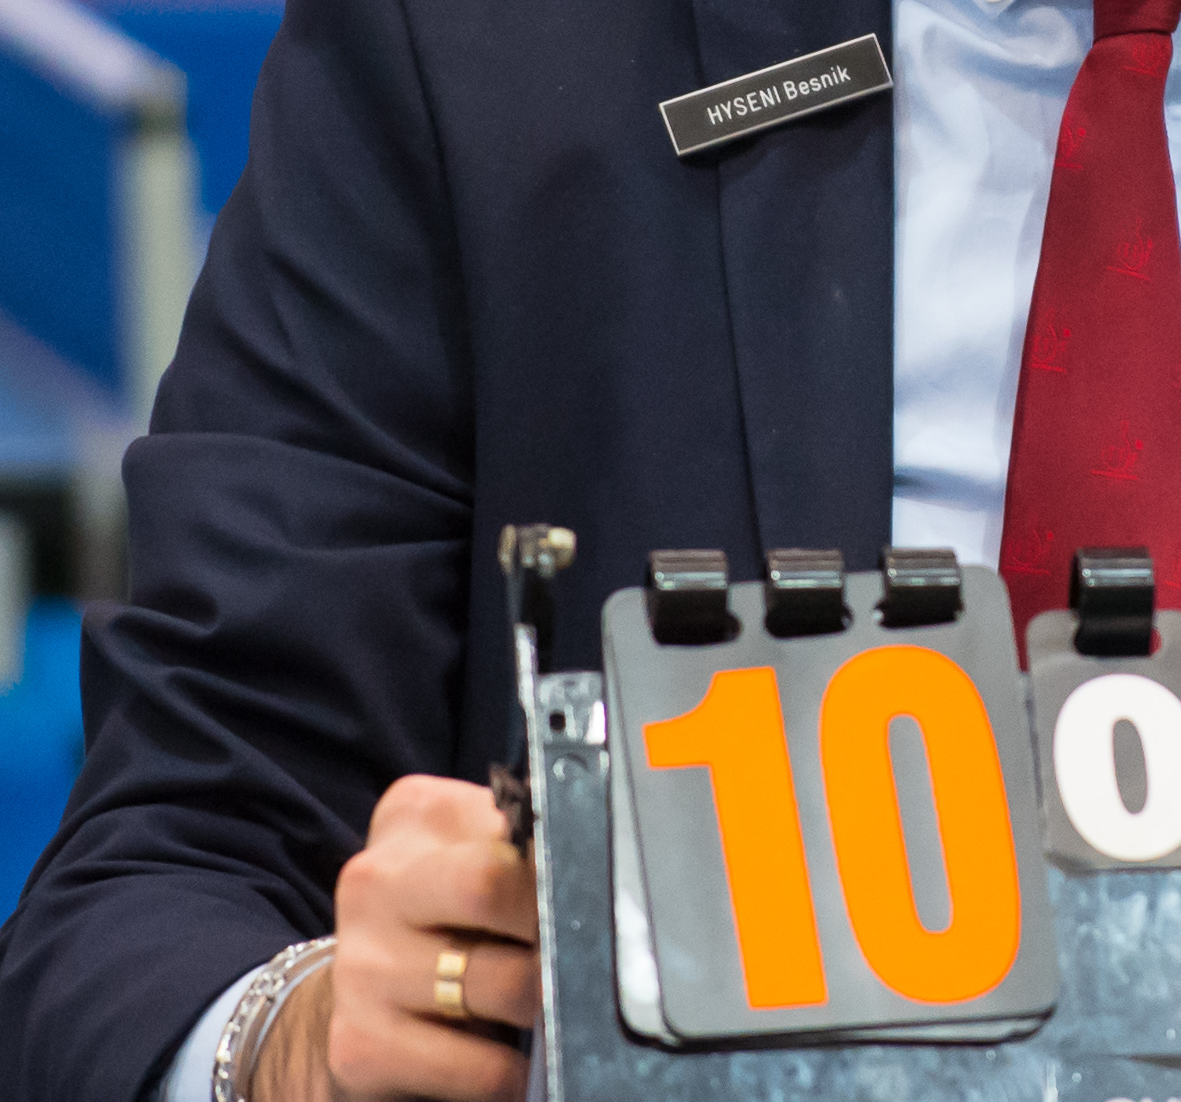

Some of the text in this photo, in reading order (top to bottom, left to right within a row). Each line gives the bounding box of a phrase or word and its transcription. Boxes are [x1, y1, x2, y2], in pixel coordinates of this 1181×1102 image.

[706, 65, 851, 125] HYSENI Besnik
[642, 644, 1022, 1010] 10
